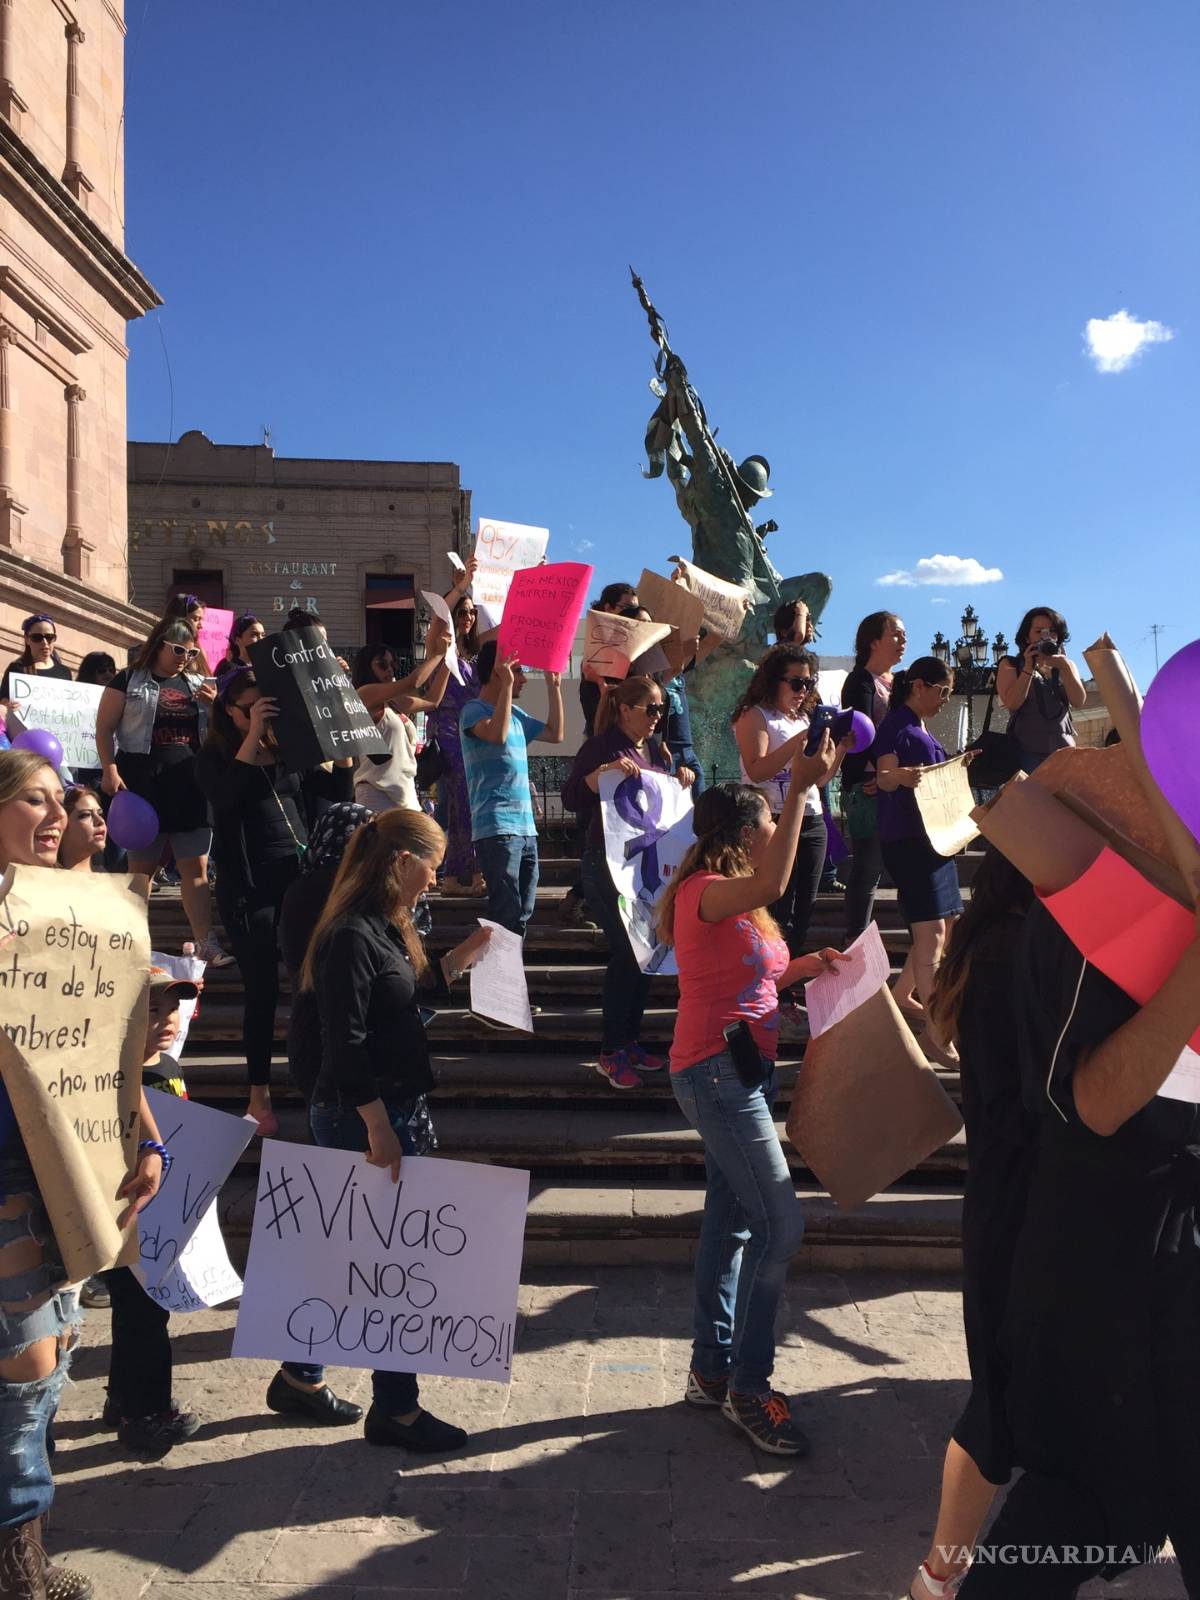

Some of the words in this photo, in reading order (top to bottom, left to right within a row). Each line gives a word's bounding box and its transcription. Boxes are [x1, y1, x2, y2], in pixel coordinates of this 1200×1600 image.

[480, 524, 520, 560] 95%
[248, 561, 337, 577] RESTAURANT
[289, 578, 304, 590] &
[273, 596, 320, 615] BAR
[271, 639, 327, 668] Contra
[315, 705, 333, 719] la
[45, 905, 98, 970] estoy
[109, 931, 133, 951] en
[61, 965, 85, 998] de
[94, 965, 115, 998] los
[3, 1014, 91, 1050] mbres!
[48, 1067, 87, 1098] cho,
[94, 1070, 126, 1093] me
[348, 1261, 438, 1308] NOS
